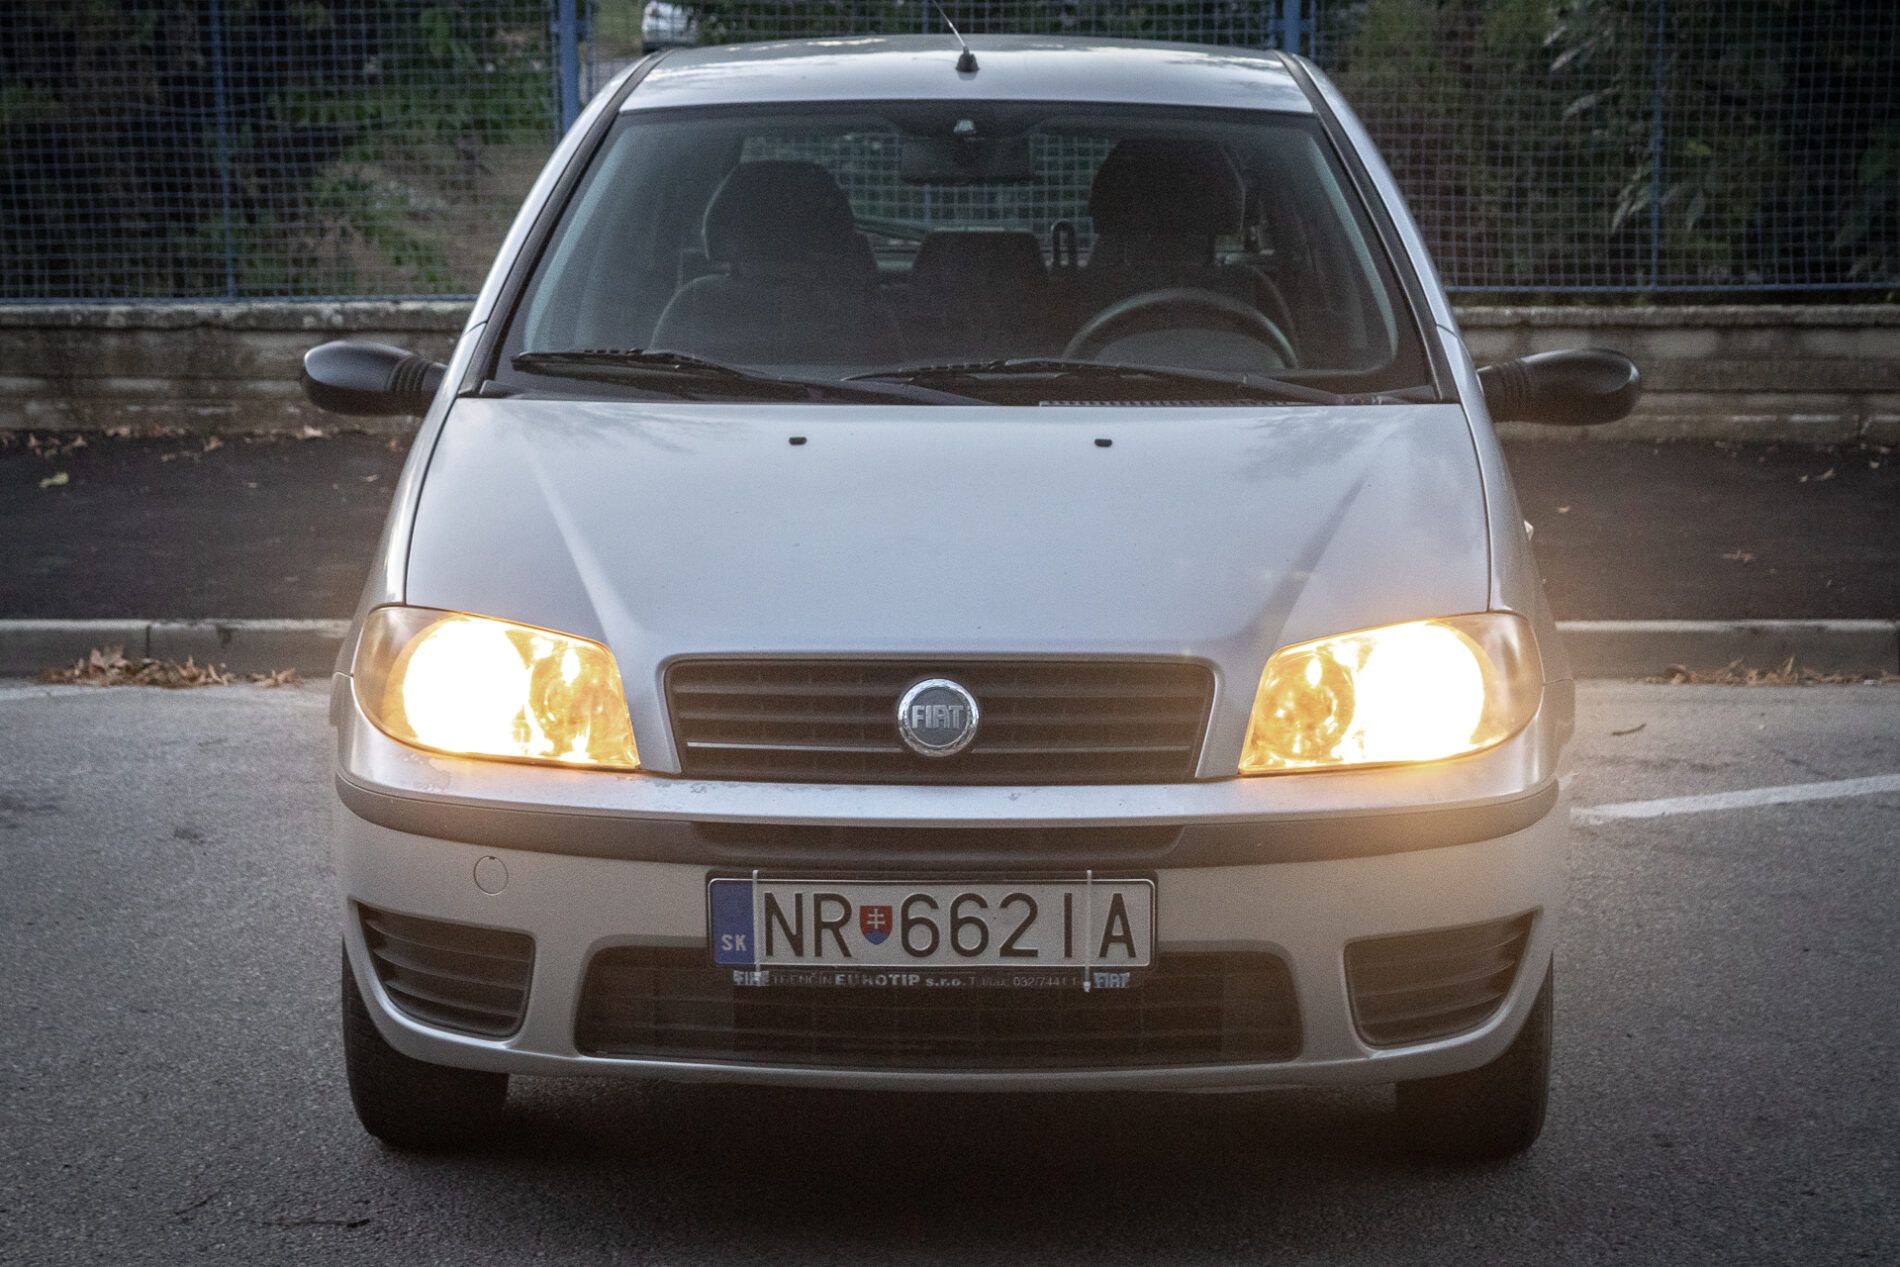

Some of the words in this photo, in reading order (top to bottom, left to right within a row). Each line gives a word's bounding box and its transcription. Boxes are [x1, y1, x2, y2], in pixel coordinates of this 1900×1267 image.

[911, 704, 964, 729] FIAT
[763, 892, 853, 958] NR
[721, 934, 747, 952] SK
[1094, 973, 1131, 988] FIAT
